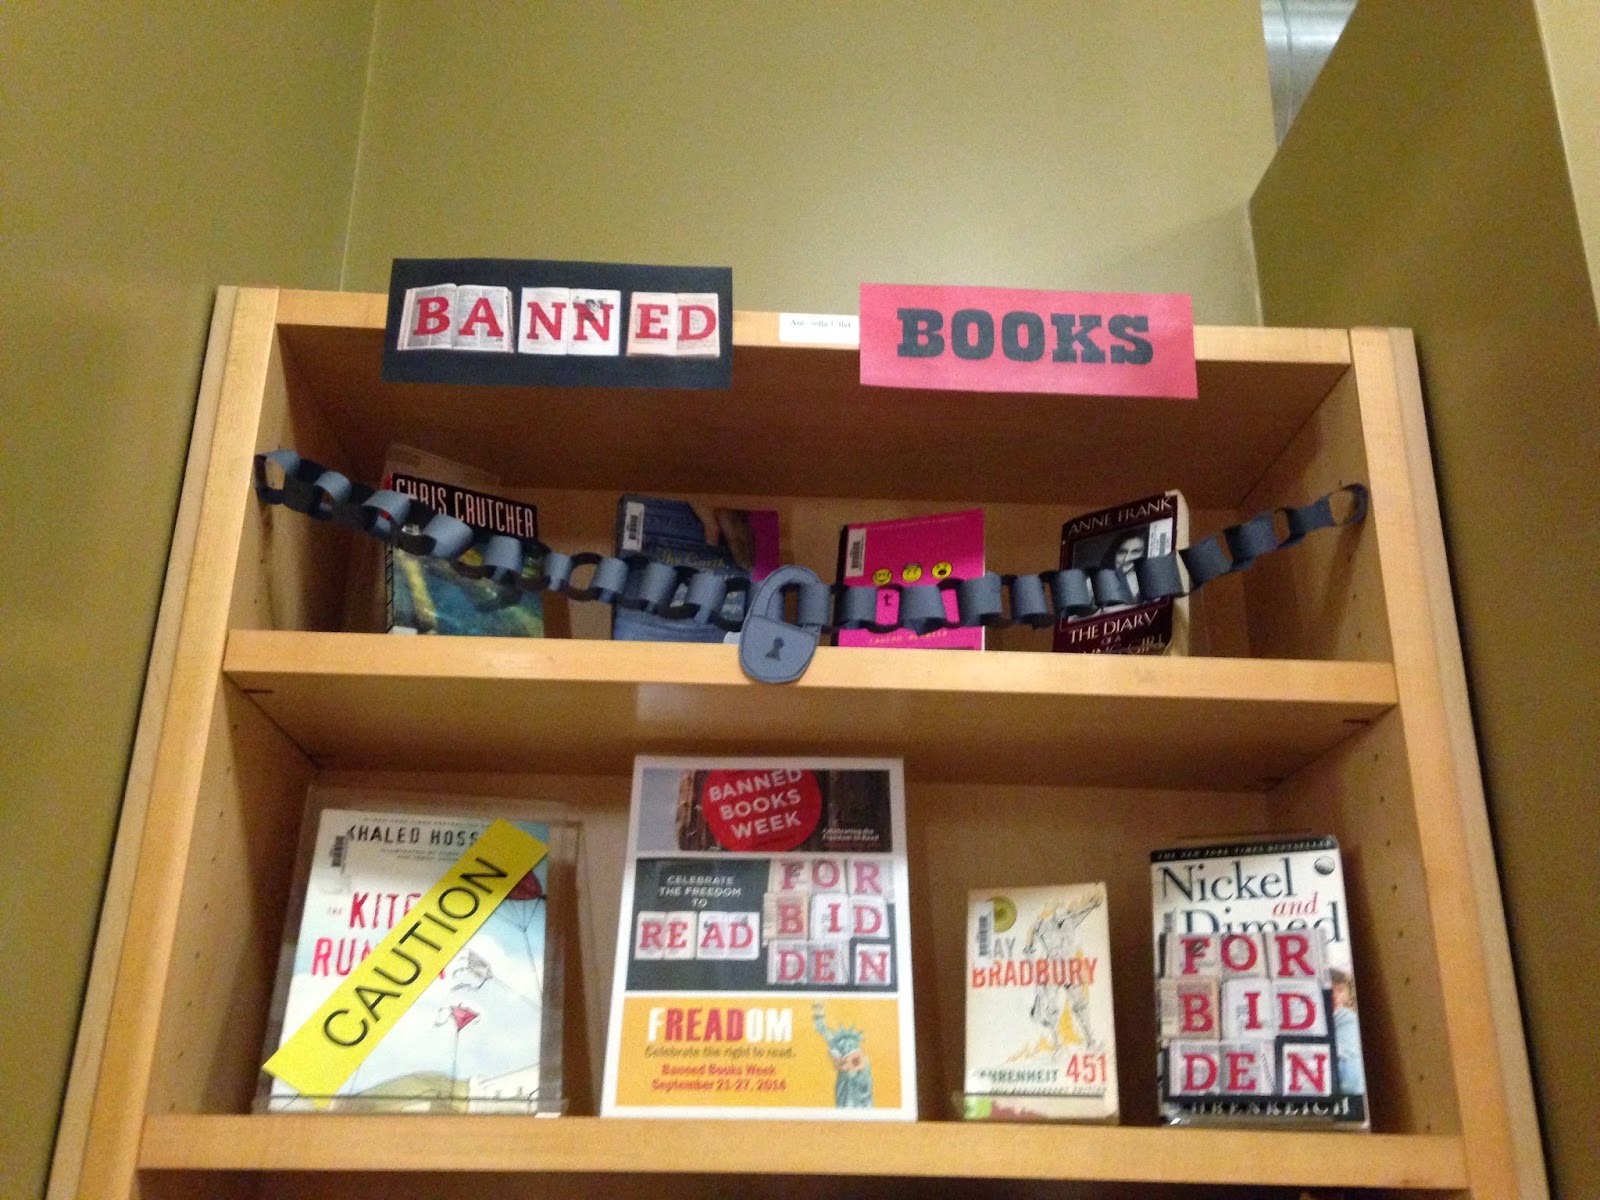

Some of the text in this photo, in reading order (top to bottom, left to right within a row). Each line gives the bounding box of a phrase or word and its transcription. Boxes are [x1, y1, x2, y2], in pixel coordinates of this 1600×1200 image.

[413, 297, 717, 342] BANNED
[897, 307, 1154, 366] BOOKS
[454, 491, 534, 537] CRUTCHER
[1068, 497, 1173, 536] ANNE FRANK
[1068, 609, 1158, 644] THE DIARY
[709, 769, 803, 802] BANNED
[719, 788, 802, 821] BOOKS
[430, 829, 479, 846] HOSS
[730, 811, 802, 839] WEEK
[659, 886, 742, 897] THE FREEDOM
[666, 875, 734, 886] CELEBRATE
[781, 859, 881, 893] FOR
[1158, 856, 1298, 903] Nickel
[692, 898, 708, 908] TO
[1272, 891, 1319, 917] and
[322, 856, 509, 1048] CAUTION
[639, 922, 754, 949] READ
[993, 936, 1016, 959] AY
[778, 950, 887, 982] DEN
[1181, 934, 1315, 977] FOR
[972, 957, 1097, 989] BRADBURY
[647, 1008, 793, 1042] FREADOM
[662, 1064, 705, 1075] Banned
[746, 1064, 776, 1075] Week
[1066, 1054, 1108, 1084] 451
[1183, 1052, 1327, 1092] DEN
